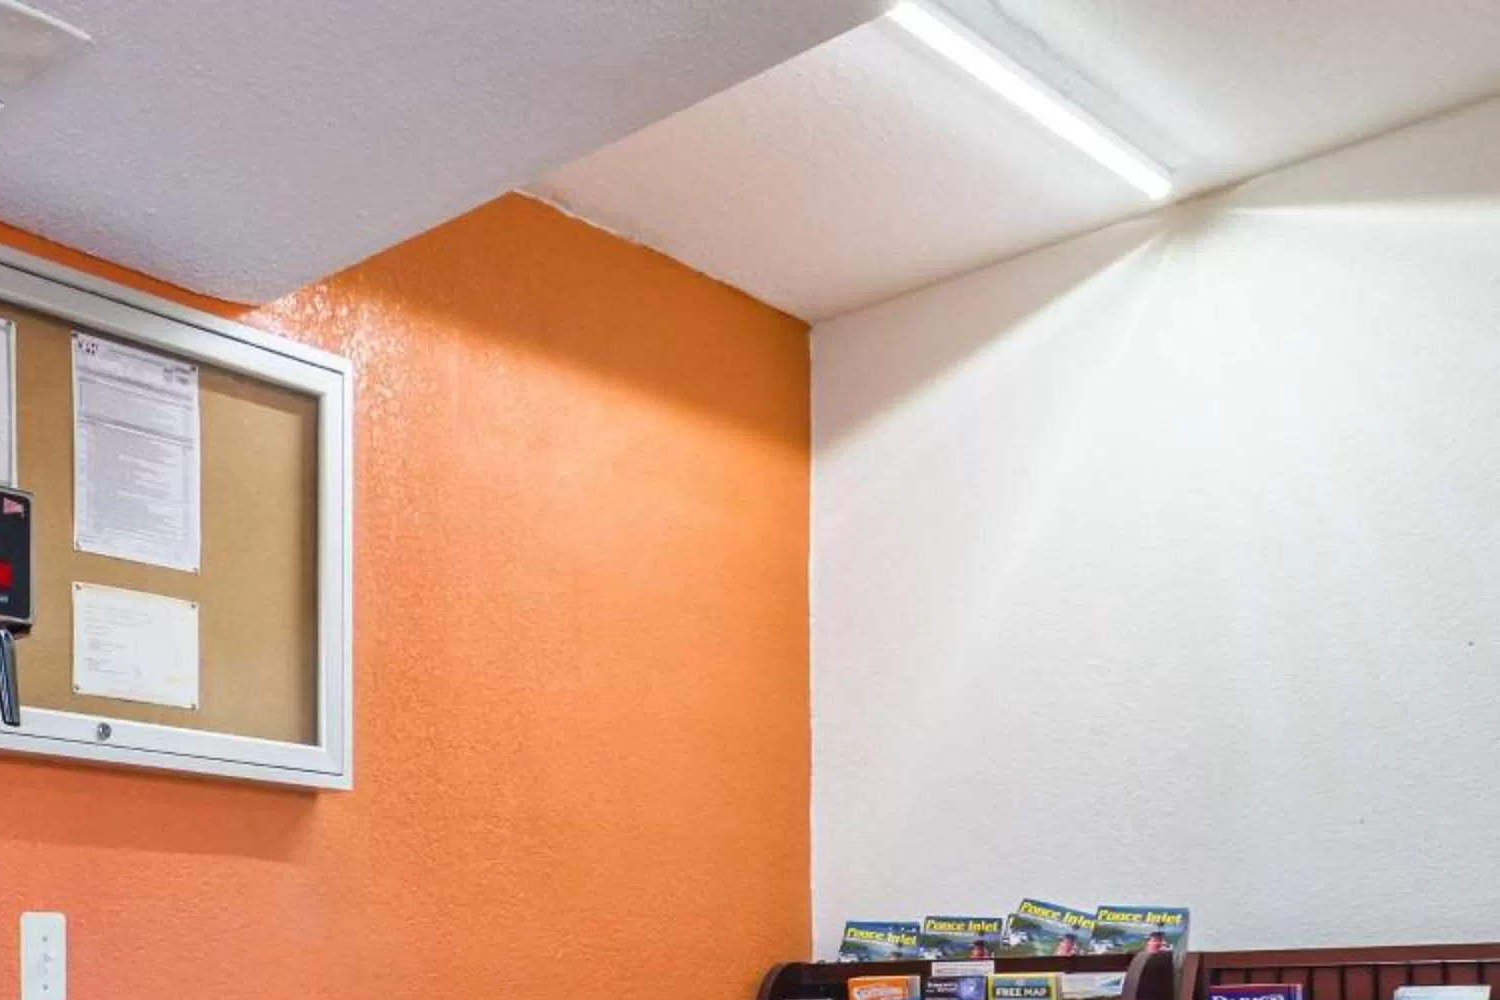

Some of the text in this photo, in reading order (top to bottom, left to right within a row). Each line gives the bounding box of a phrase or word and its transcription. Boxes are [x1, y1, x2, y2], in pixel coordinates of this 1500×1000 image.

[1098, 909, 1183, 924] Ponce Inlet
[926, 919, 998, 932] Ponce Inlet
[996, 987, 1048, 998] FREE MAP
